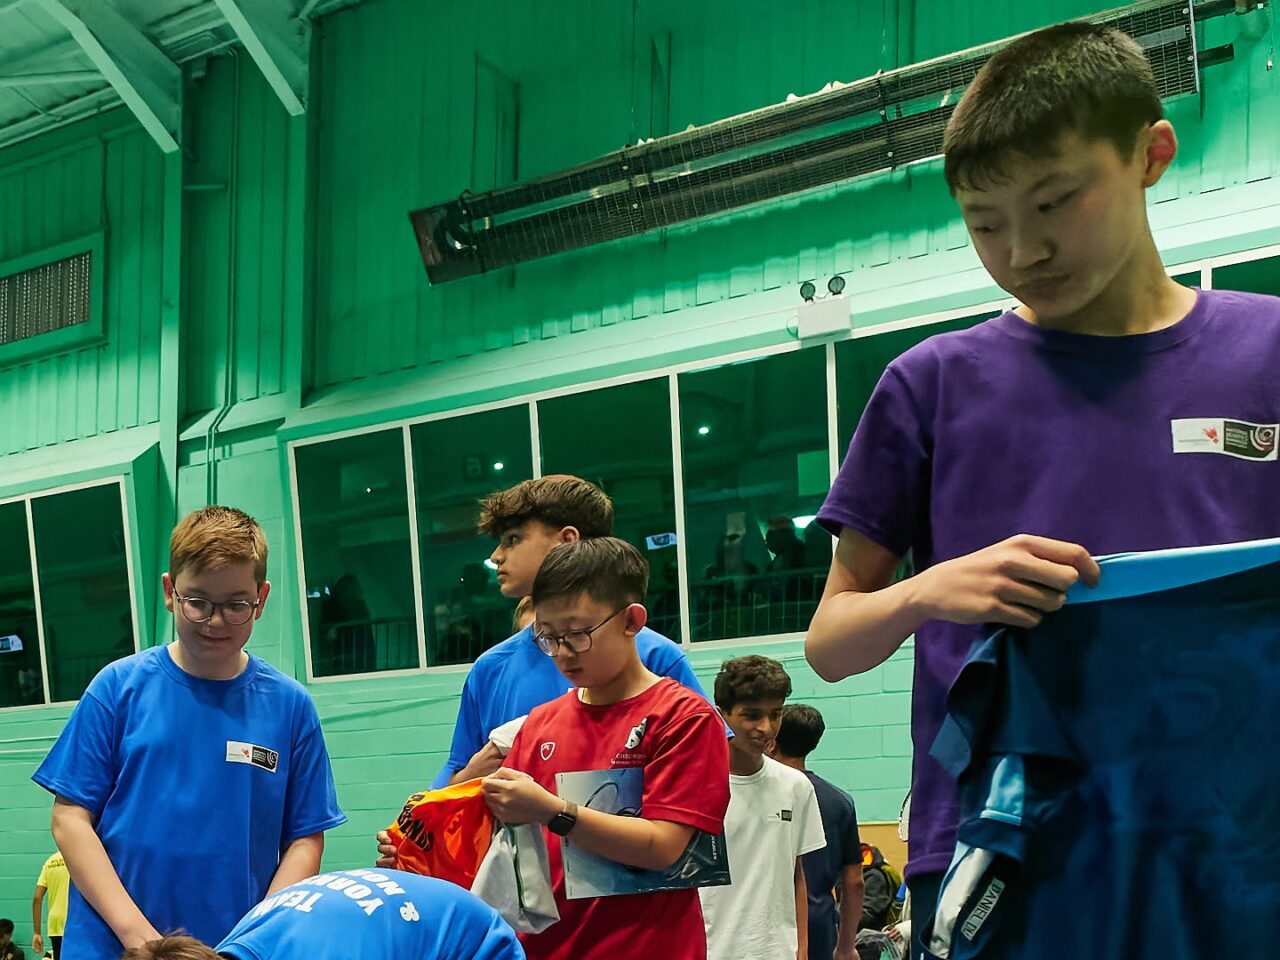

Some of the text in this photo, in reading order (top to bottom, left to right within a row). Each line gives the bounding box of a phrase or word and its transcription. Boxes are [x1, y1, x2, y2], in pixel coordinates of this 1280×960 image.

[251, 890, 323, 919] TEAM
[294, 874, 384, 916] YORK
[399, 901, 420, 922] &
[971, 883, 1002, 921] DANIEL
